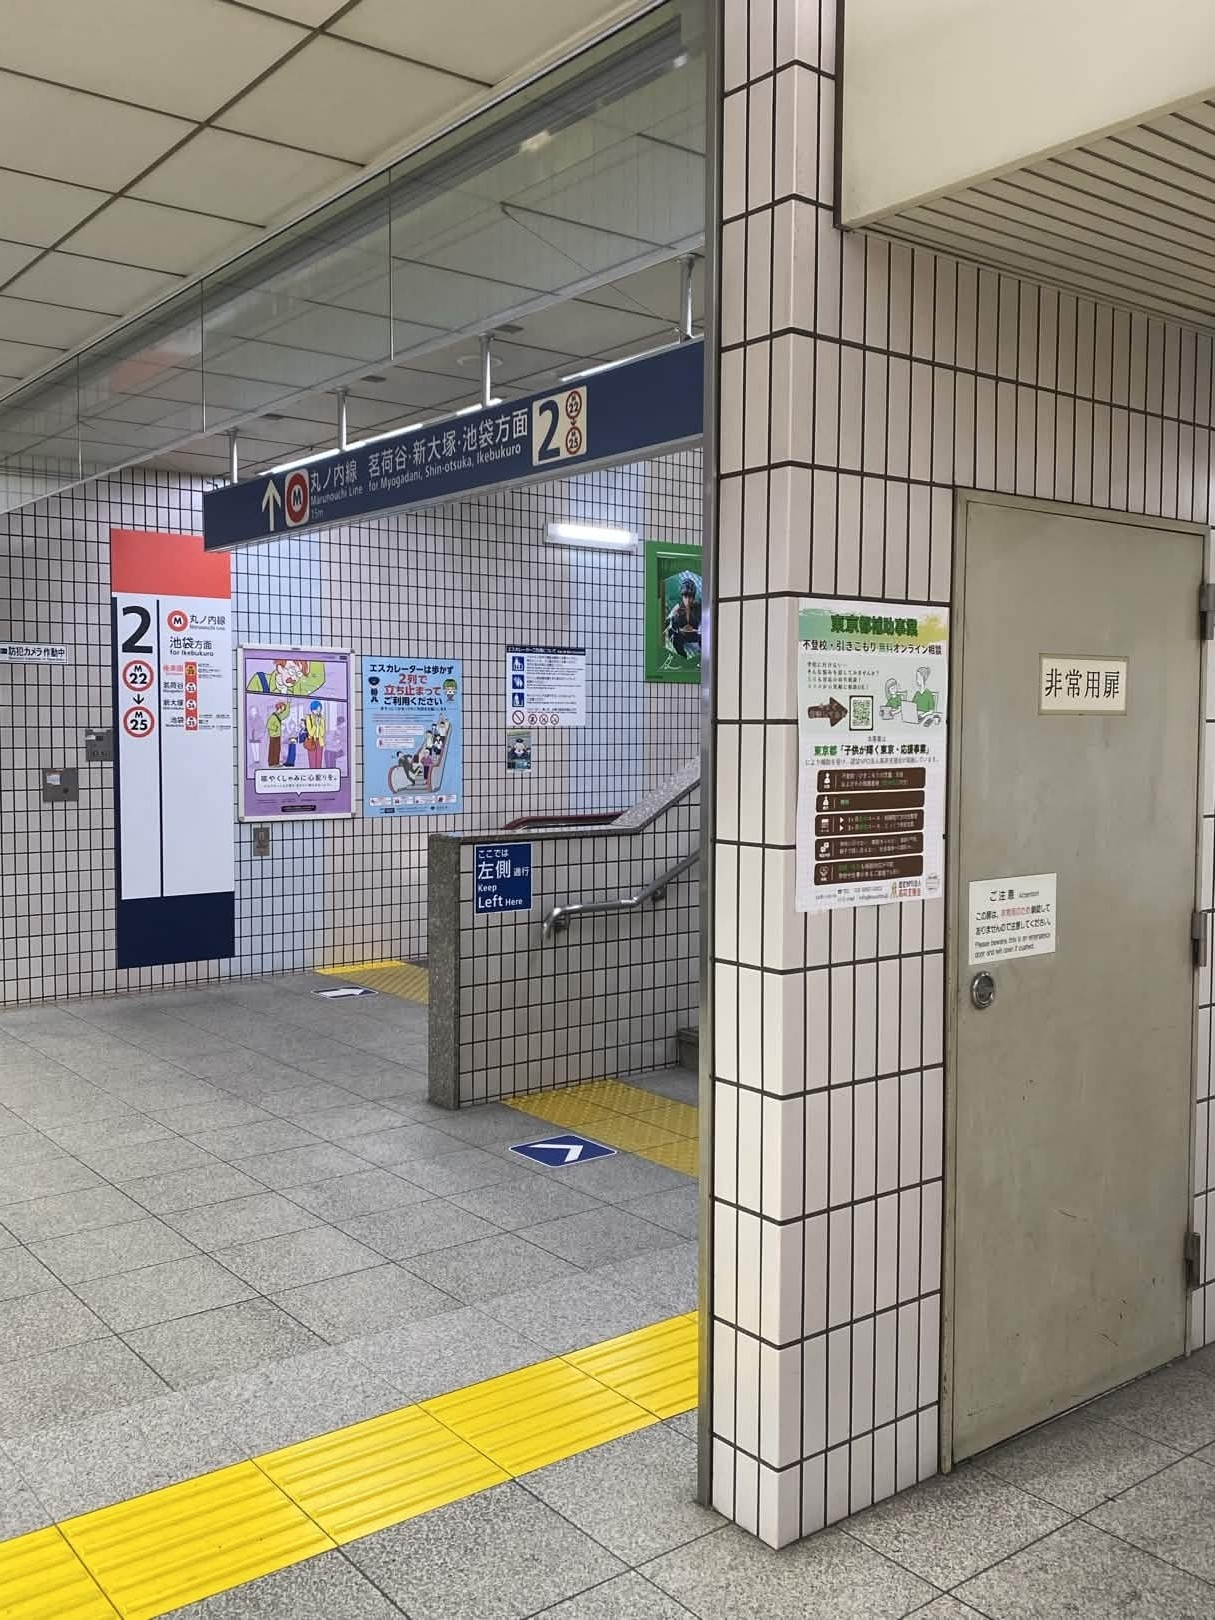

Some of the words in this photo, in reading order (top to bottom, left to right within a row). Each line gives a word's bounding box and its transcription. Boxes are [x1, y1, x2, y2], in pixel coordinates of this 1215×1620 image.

[568, 401, 579, 414] 22
[538, 399, 561, 462] 2
[568, 438, 579, 449] 25
[368, 480, 379, 492] for
[476, 443, 521, 464] Ikebukuro
[310, 459, 357, 492] 丸ノ内線
[348, 485, 363, 497] Line
[293, 488, 302, 507] M
[173, 617, 182, 625] M
[189, 614, 226, 625] 丸ノ内線
[830, 614, 919, 637] 東京都補助事業
[121, 605, 153, 654] 2
[169, 636, 212, 650] 池袋方面
[369, 664, 454, 675] エスカレーターは歩かず
[129, 673, 148, 685] 22
[398, 673, 428, 685] 2列で
[1045, 668, 1120, 699] 非常用扉
[383, 684, 441, 696] 立ち止まって
[383, 696, 443, 706] ご利用ください
[134, 711, 143, 719] M
[129, 719, 148, 731] 25
[478, 848, 509, 859] ここでは
[478, 859, 511, 880] 左側
[513, 866, 530, 877] 通行
[478, 883, 497, 893] Keep
[990, 889, 1014, 901] ご注意
[478, 894, 503, 909] Left
[505, 898, 523, 907] Here
